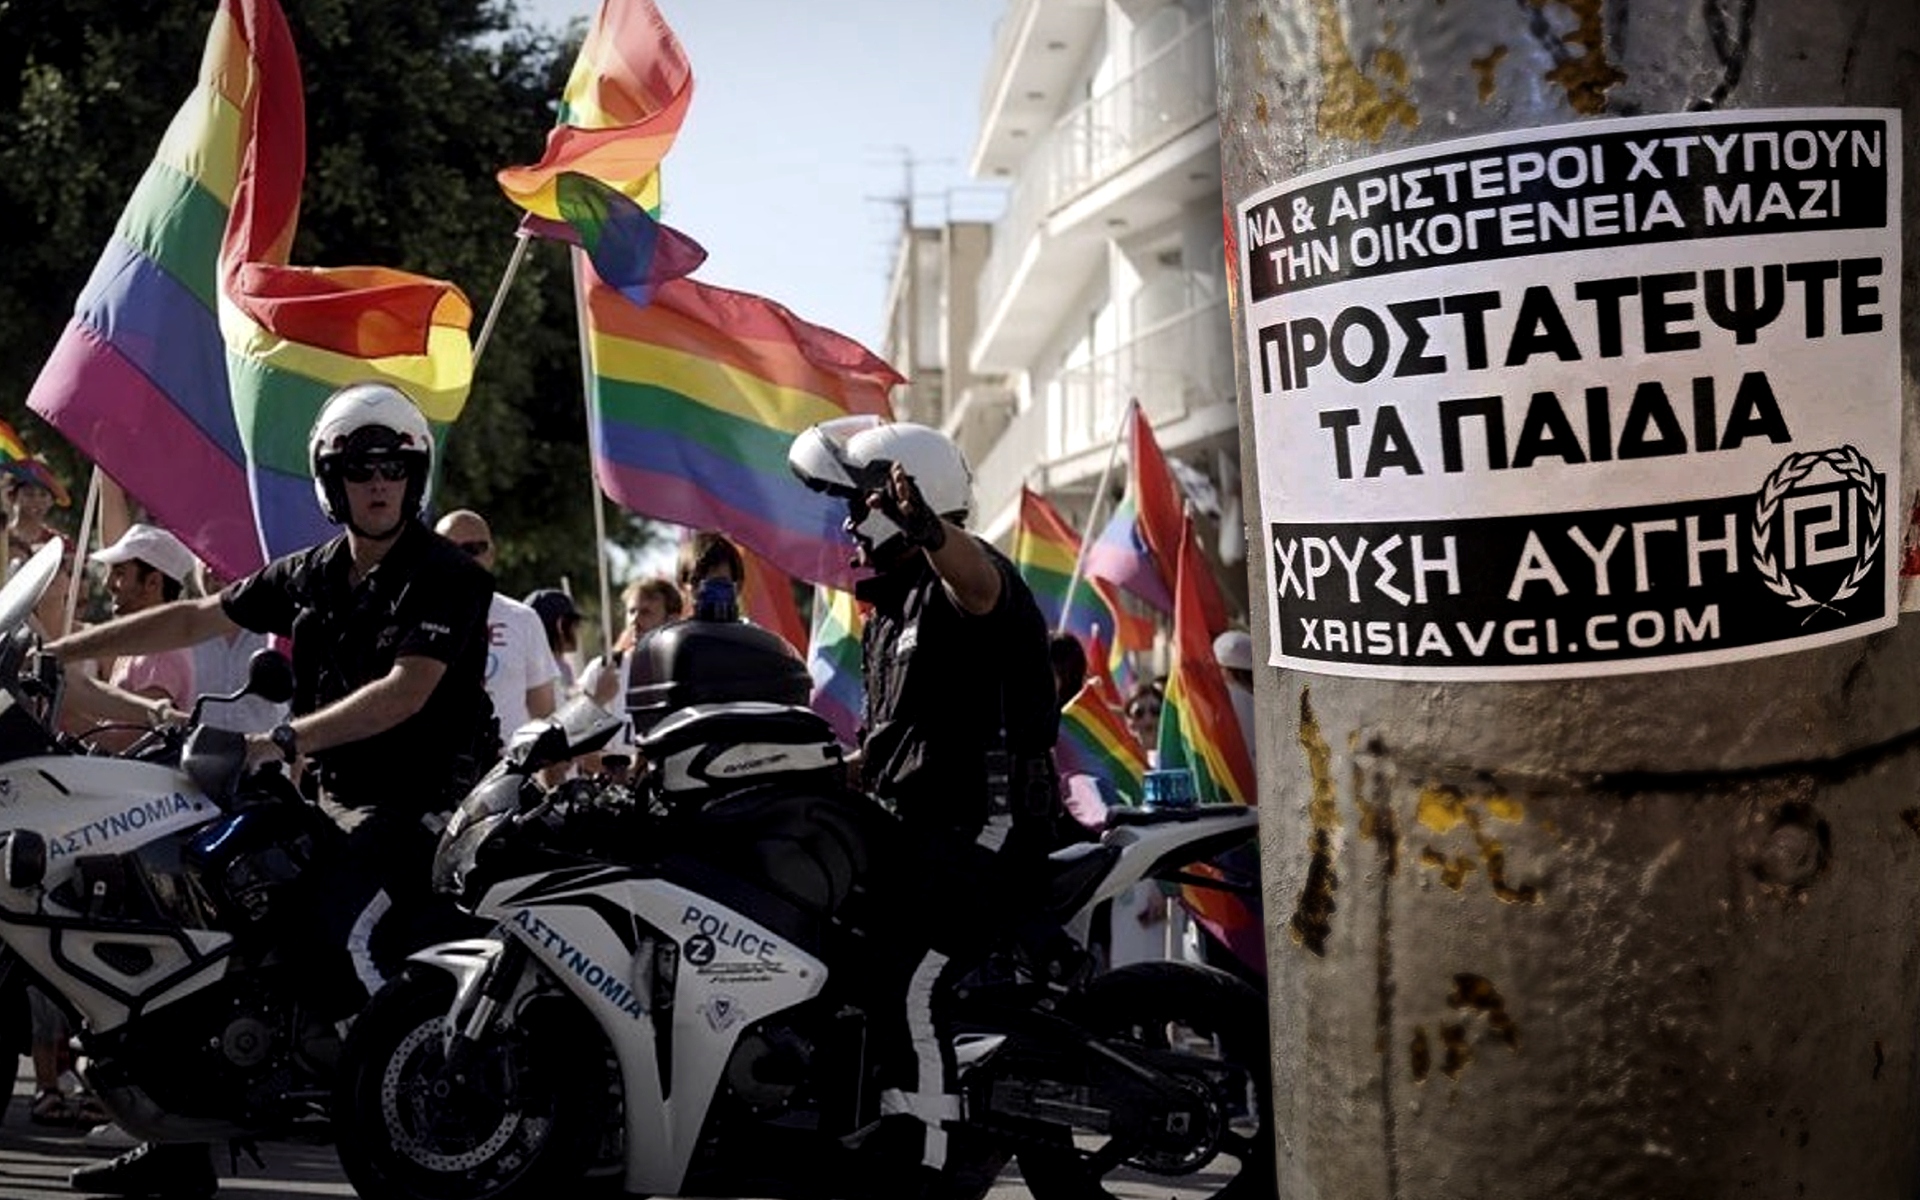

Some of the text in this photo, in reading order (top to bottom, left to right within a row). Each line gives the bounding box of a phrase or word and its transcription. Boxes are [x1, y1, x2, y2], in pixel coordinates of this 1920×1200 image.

[1247, 130, 1882, 253] ΝΔ & ΑΡΙΣΤΕΡΟΙ ΧΤΥΠΟΥΝ
[1270, 180, 1842, 285] ΤΗΝ ΟΙΚΟΓΕΝΕΙΑ ΜΑΖΙ
[1258, 257, 1883, 393] ΠΡΟΣΤΑΤΕΨΤΕ
[1319, 371, 1791, 480] ΤΑ ΠΑΙΔΙΑ
[1274, 514, 1738, 607] ΧΡΥΣΗ ΑΥΓΗ
[1300, 604, 1721, 657] XRISIAVGI.COM
[51, 792, 190, 861] ΑΣΤΥΝΟΜΙΑ
[513, 909, 642, 1019] ΑΣΤΥΝΟΜΙΑ
[682, 906, 777, 964] POLICE
